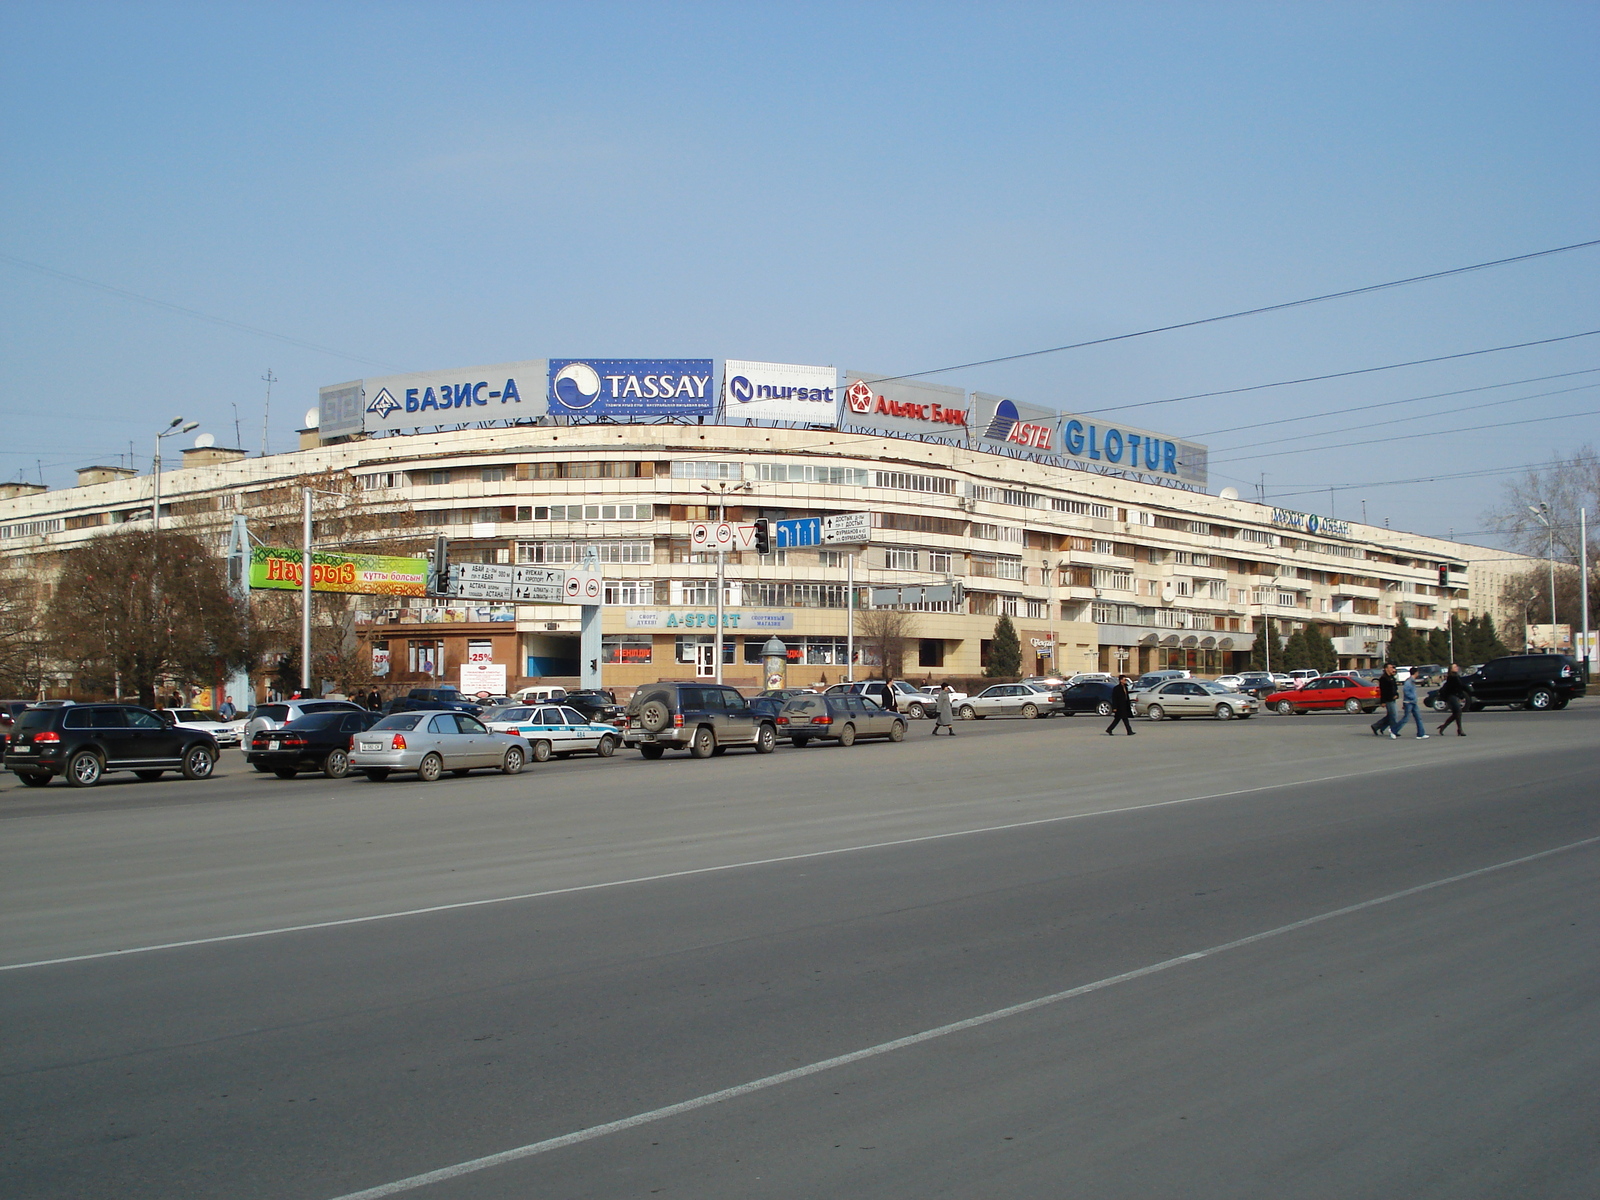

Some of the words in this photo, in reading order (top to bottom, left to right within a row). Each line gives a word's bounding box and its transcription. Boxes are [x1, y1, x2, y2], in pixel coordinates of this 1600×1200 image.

[405, 378, 522, 413] БАЗИС-А
[605, 375, 710, 399] TASSAY
[757, 383, 834, 403] nursat
[1005, 421, 1053, 450] ASTEL
[1065, 419, 1178, 475] GLOTUR
[390, 572, 424, 582] болсын!
[666, 613, 741, 628] A-SPORT
[469, 653, 493, 662] -25%
